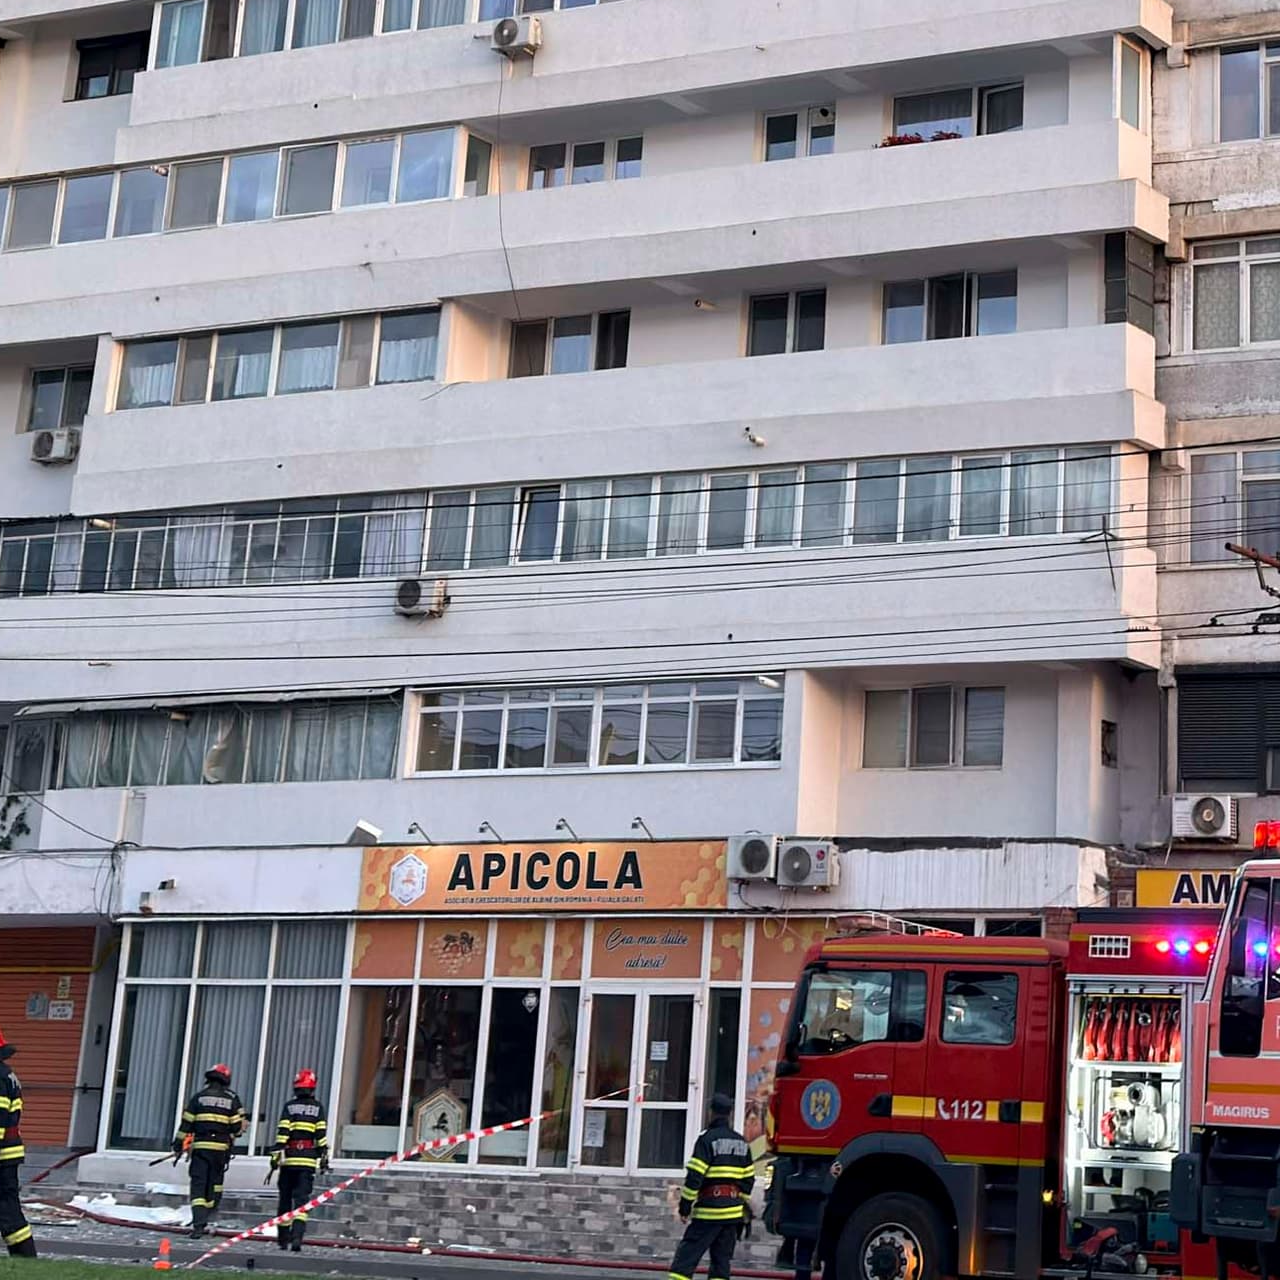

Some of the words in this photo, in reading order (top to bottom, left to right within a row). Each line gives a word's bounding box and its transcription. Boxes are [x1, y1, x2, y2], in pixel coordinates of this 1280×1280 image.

[447, 851, 643, 891] APICOLA
[661, 928, 688, 944] dulce
[950, 1100, 983, 1119] 112
[1213, 1105, 1270, 1118] MAGIRUS
